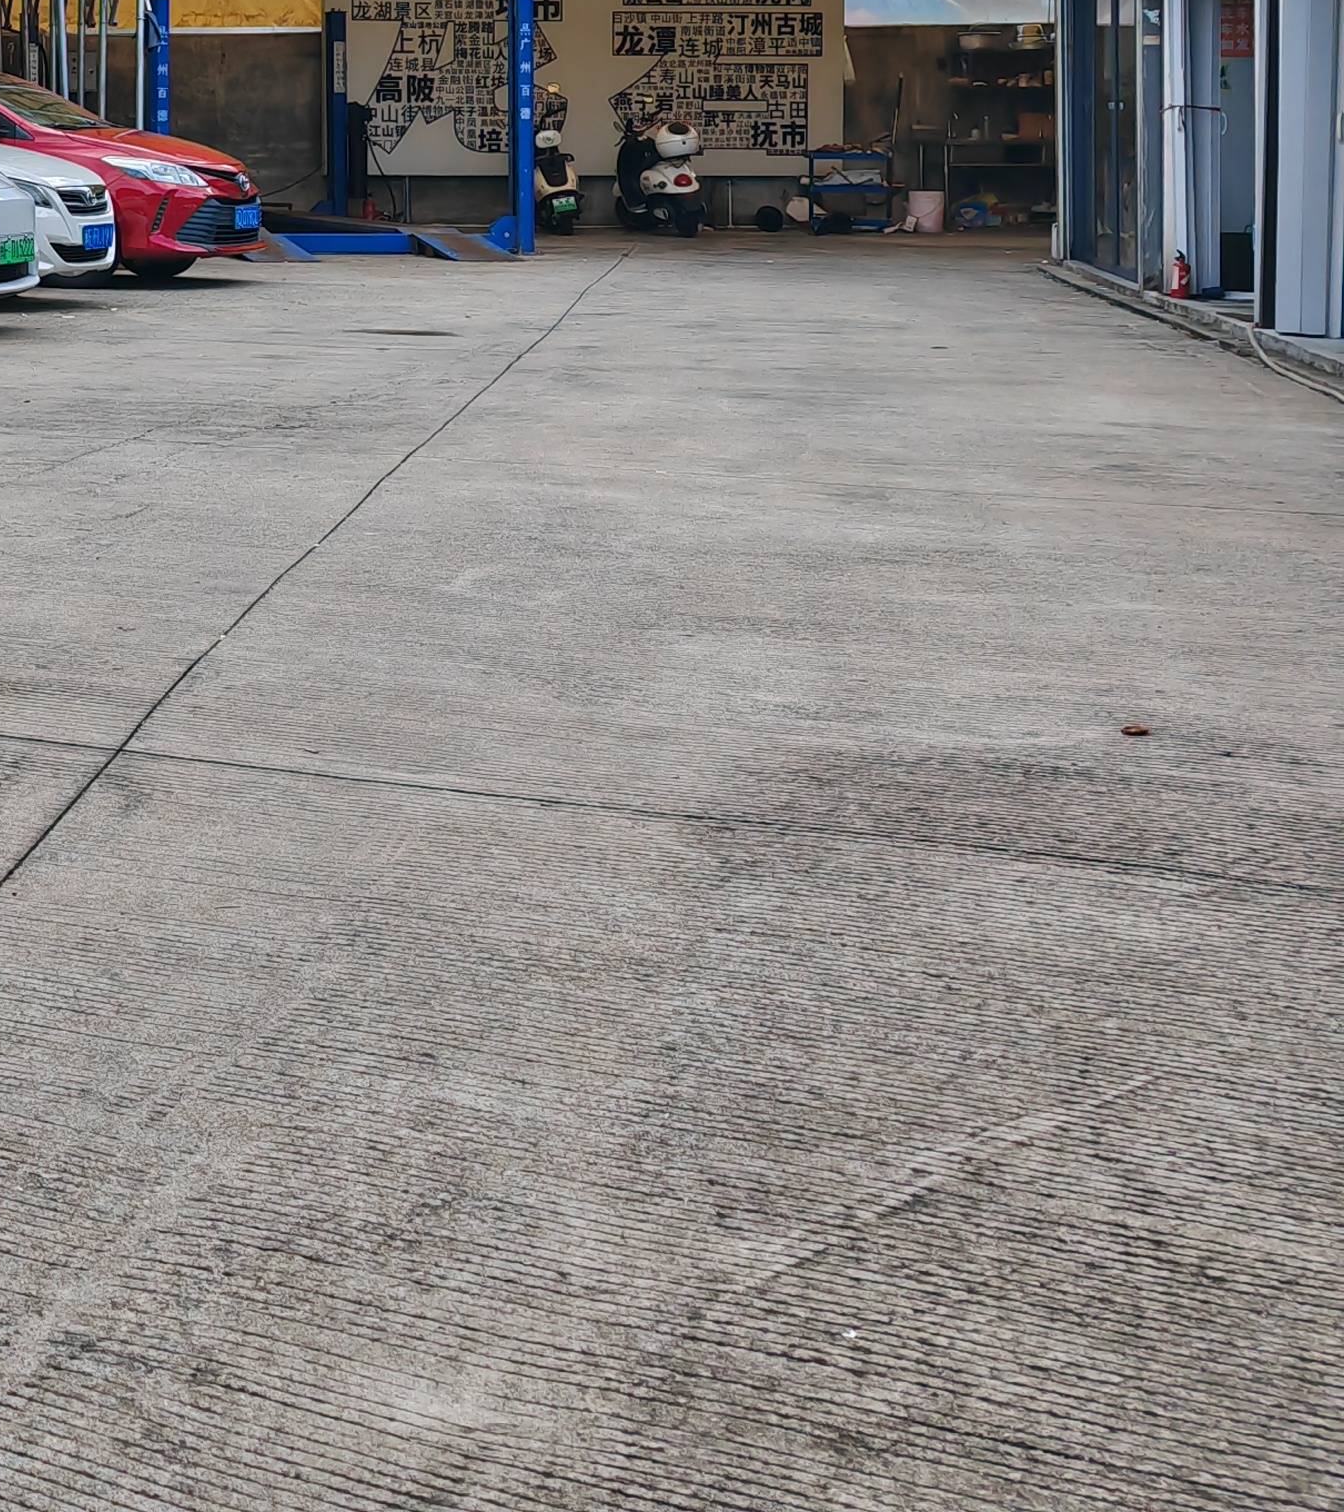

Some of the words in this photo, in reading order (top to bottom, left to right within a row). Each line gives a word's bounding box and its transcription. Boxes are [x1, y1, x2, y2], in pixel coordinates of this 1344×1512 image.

[353, 0, 434, 20] 龙湖景区
[727, 12, 823, 37] 汀州古城
[392, 29, 443, 55] 上杭
[614, 25, 678, 56] 龙潭
[375, 73, 436, 104] 高陂
[768, 99, 808, 120] 古田
[751, 120, 807, 148] 抚市
